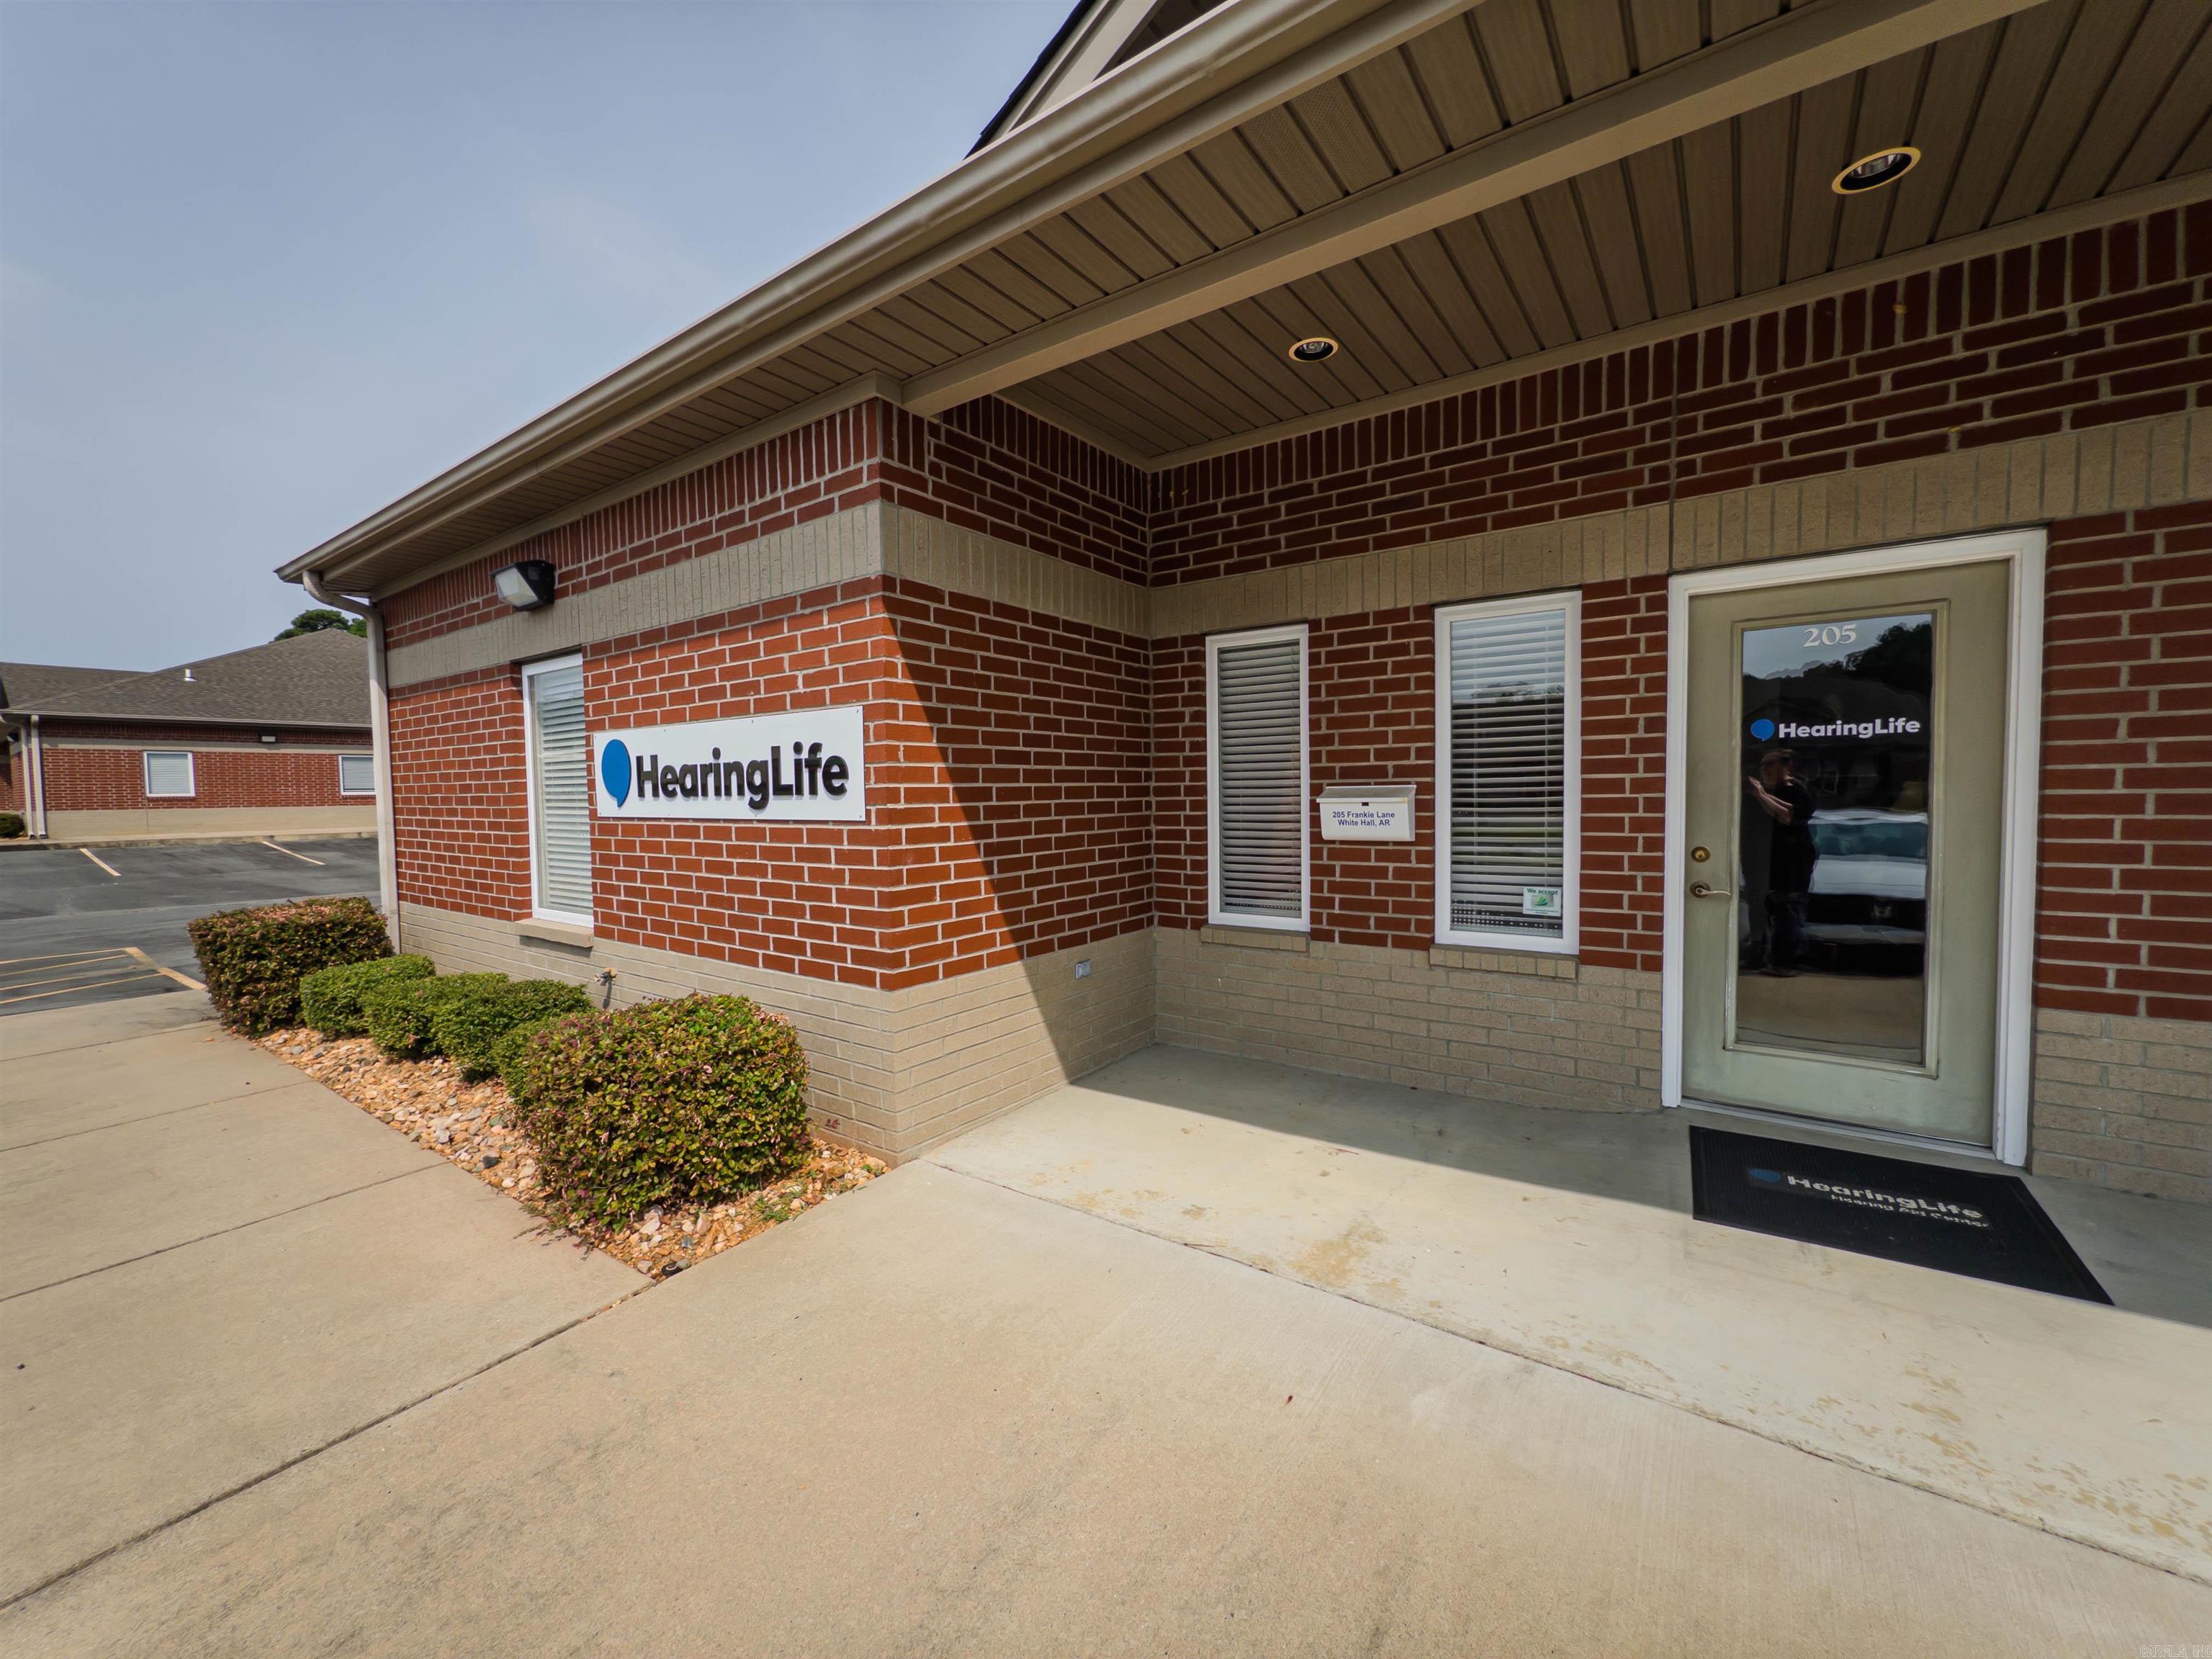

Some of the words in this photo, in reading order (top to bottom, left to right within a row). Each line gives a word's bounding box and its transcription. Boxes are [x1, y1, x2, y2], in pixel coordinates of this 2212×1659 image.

[1803, 624, 1857, 647] 205
[1779, 718, 1921, 739] HearingLife
[635, 741, 849, 809] HearingLife
[1787, 1175, 1982, 1218] HearingLife
